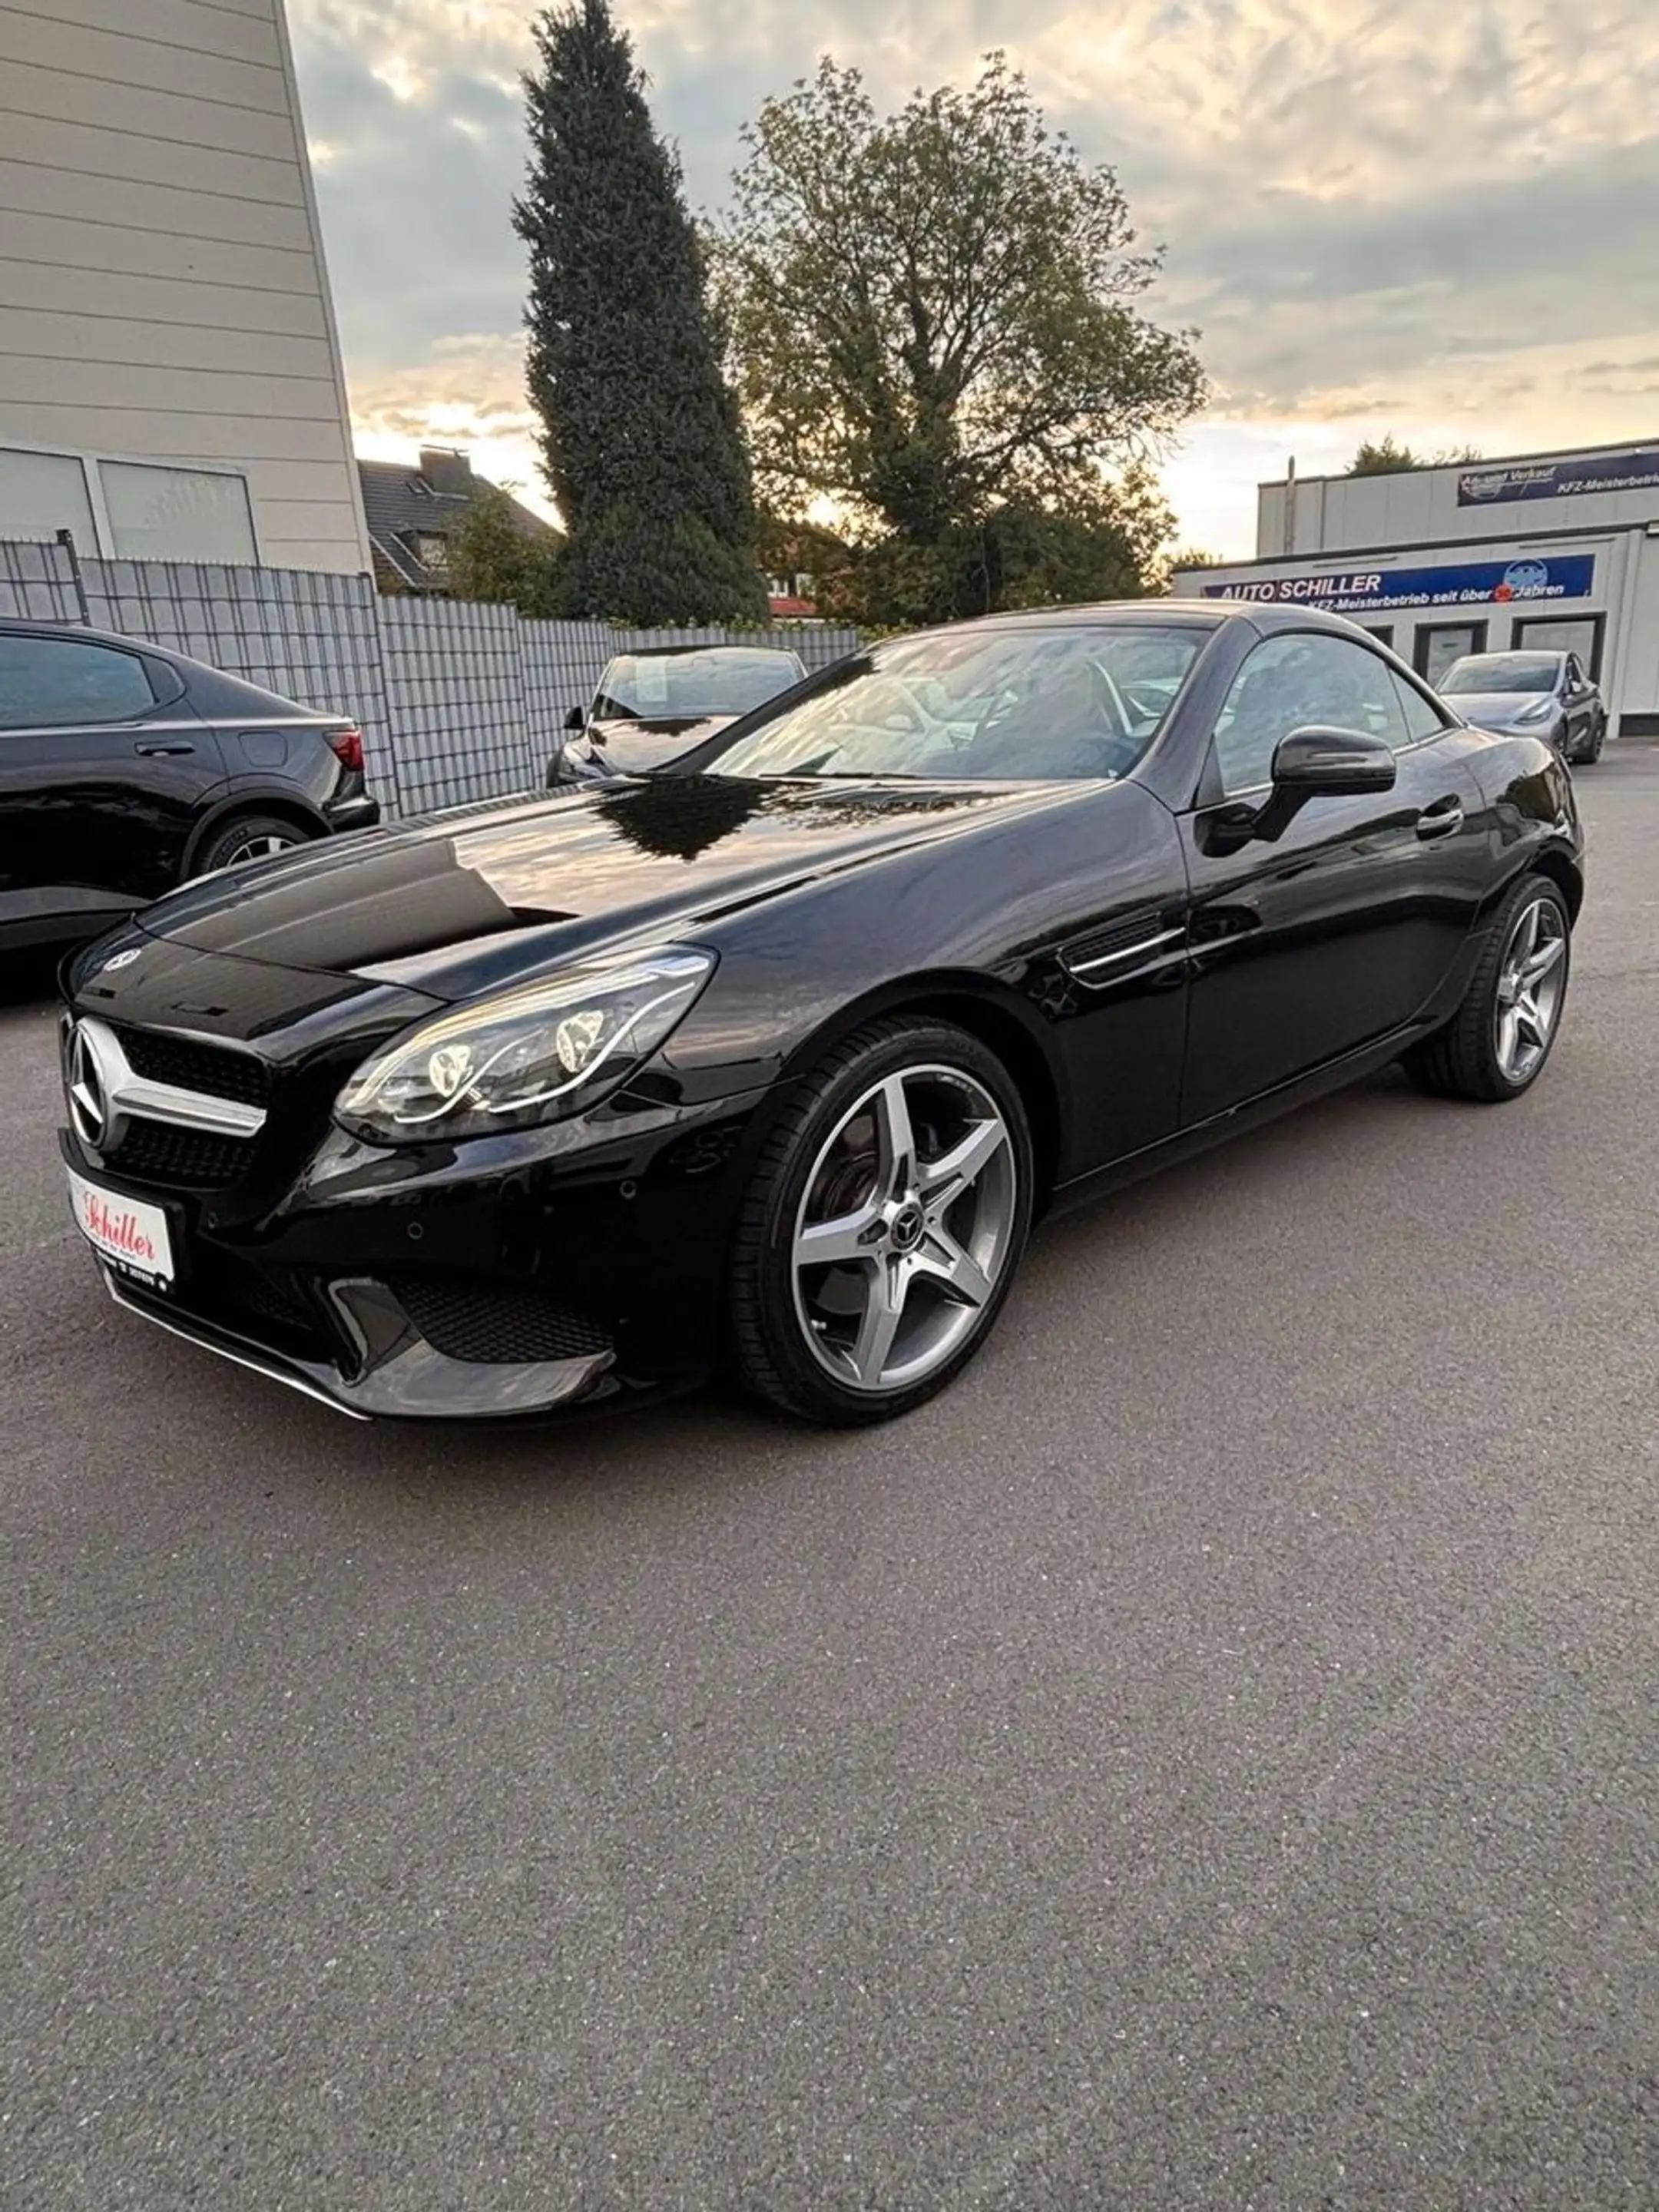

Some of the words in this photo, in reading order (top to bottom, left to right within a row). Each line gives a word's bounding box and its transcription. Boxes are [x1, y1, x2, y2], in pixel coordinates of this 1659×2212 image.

[1221, 583, 1274, 600] AUTO
[1279, 575, 1381, 599] SCHILLER
[1309, 592, 1429, 611] KFZ-Meisterbetrieb
[1432, 591, 1458, 604] seit
[1460, 588, 1492, 601] über
[1514, 584, 1565, 598] Jahren
[84, 1190, 155, 1260] Schiller
